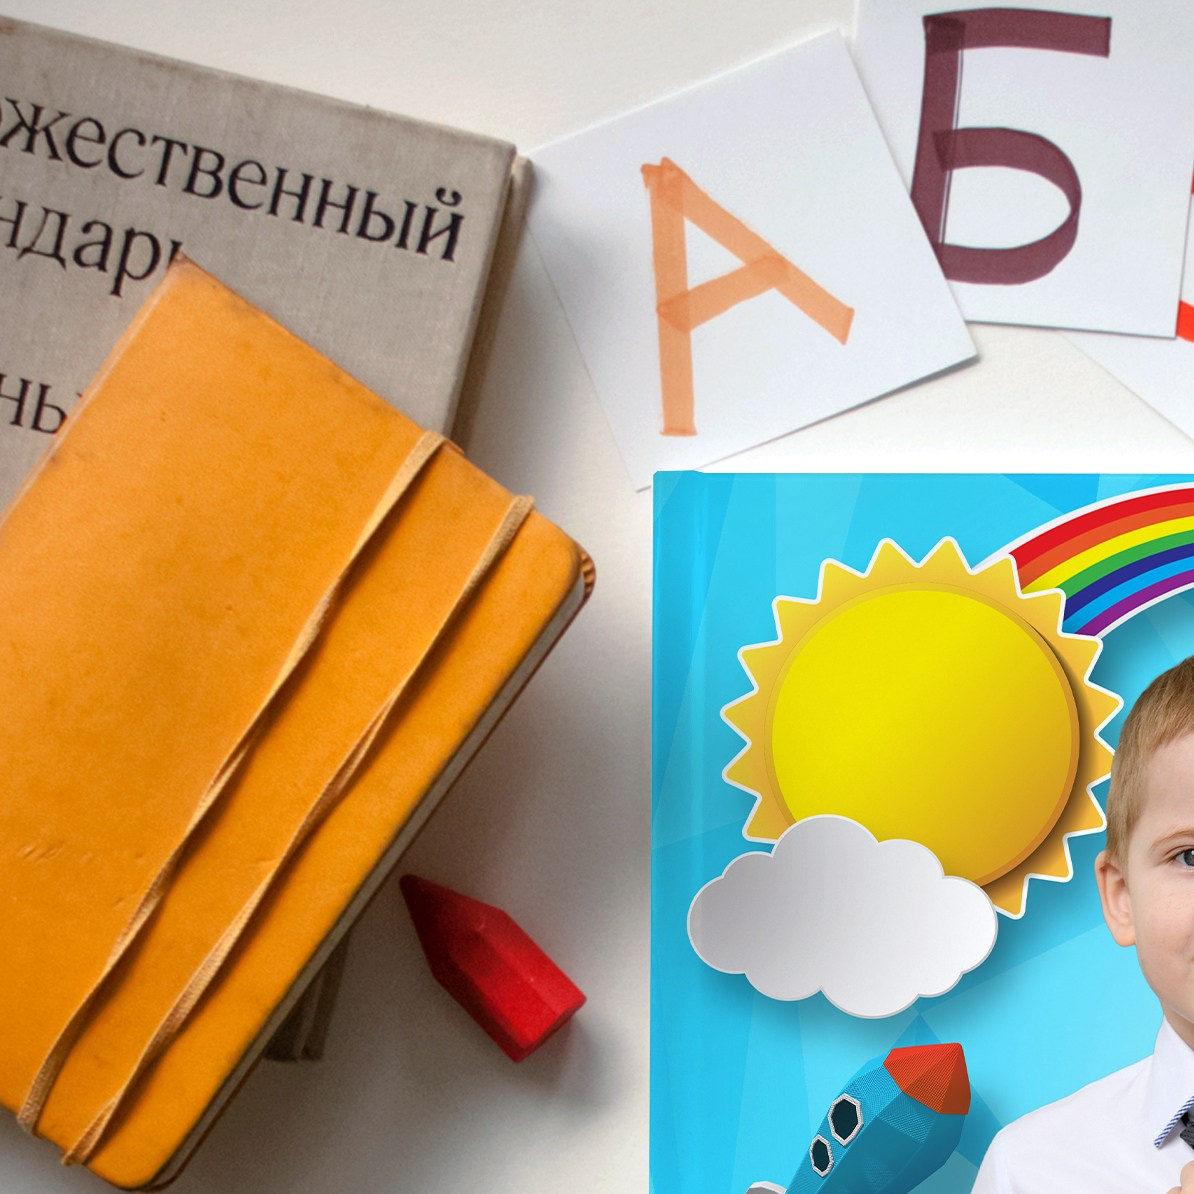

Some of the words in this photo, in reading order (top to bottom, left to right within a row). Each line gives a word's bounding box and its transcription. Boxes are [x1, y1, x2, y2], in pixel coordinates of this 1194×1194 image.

[0, 97, 465, 263] жественный
[911, 8, 1112, 285] Б
[640, 156, 855, 437] А
